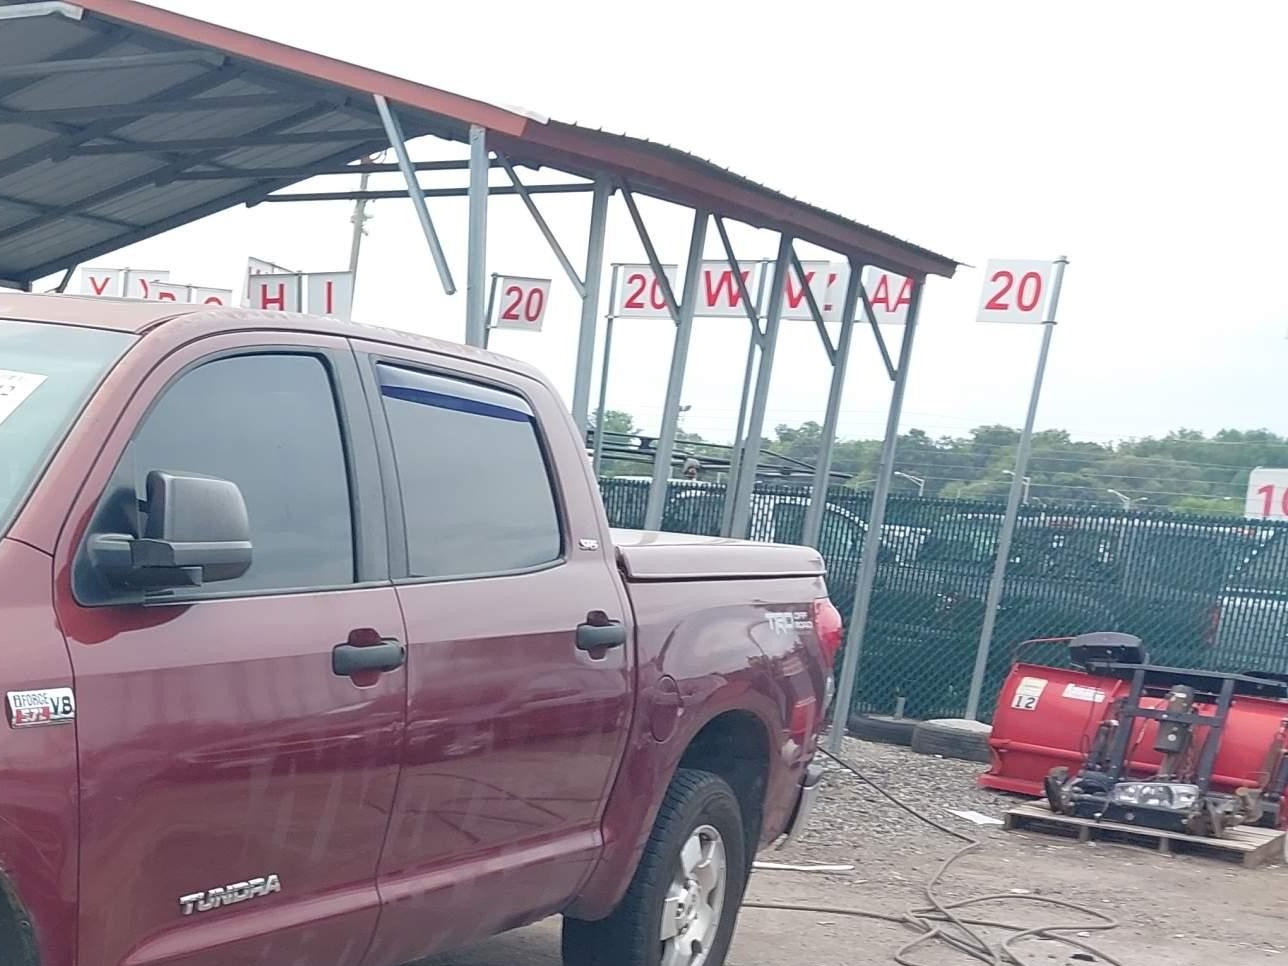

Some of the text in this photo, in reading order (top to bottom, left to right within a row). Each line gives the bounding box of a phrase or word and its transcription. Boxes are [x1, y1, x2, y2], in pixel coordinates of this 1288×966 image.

[261, 283, 285, 311] H
[501, 286, 544, 322] 20
[704, 271, 750, 307] W
[985, 270, 1042, 311] 20
[1015, 695, 1036, 709] 12
[179, 874, 282, 915] TUNDRA
